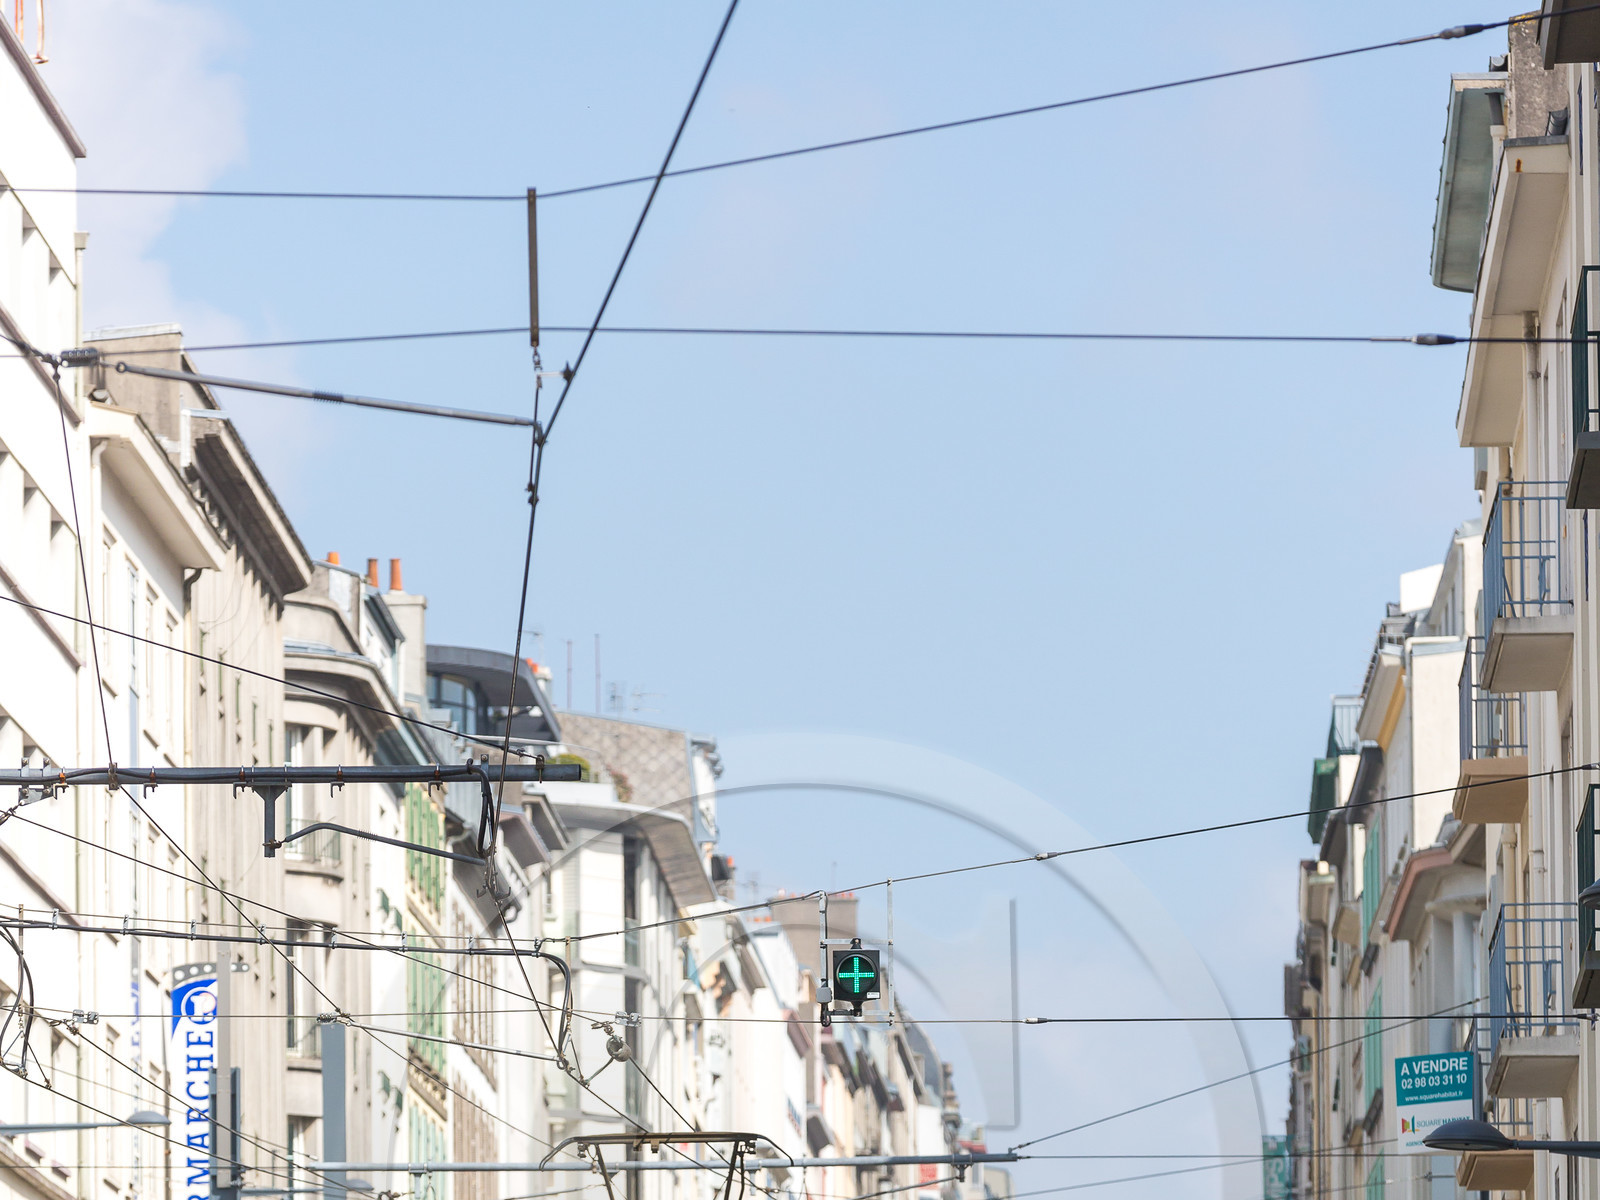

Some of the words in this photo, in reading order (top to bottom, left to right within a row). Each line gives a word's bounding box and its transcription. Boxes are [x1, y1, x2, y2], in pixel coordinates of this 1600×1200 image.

[1400, 1062, 1410, 1076] A
[1412, 1057, 1468, 1075] VENDRE
[1401, 1078, 1412, 1089] 02
[1414, 1076, 1426, 1088] 98
[1428, 1075, 1440, 1087] 03
[1442, 1074, 1453, 1085] 31
[1456, 1073, 1467, 1084] 10
